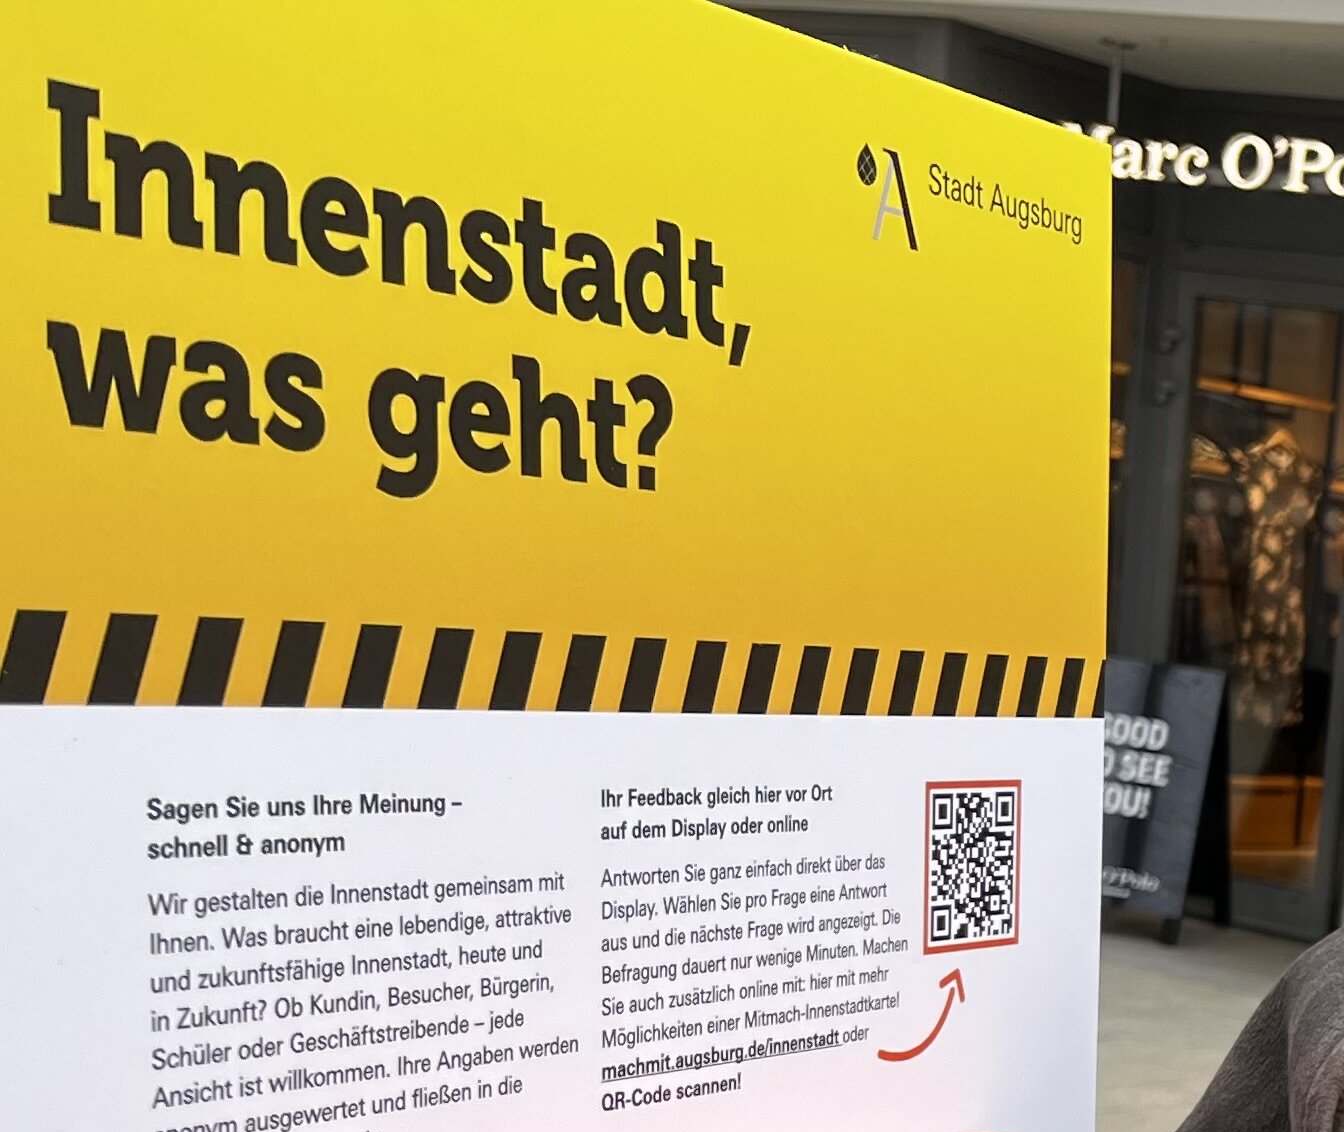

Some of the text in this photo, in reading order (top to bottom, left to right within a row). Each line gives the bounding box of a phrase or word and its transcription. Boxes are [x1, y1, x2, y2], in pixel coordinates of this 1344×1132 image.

[1062, 122, 1209, 186] arc
[46, 78, 751, 373] Innenstadt,
[929, 164, 1081, 245] Stadt Augsburg
[46, 320, 673, 498] was geht?
[1104, 711, 1170, 750] OOD
[1117, 749, 1173, 787] SEE
[147, 793, 445, 825] Sagen Sie uns Ihre Meinung
[601, 784, 832, 809] Ihr Feedback gleich hier vor Ort
[1104, 780, 1151, 819] OU!
[147, 834, 345, 859] schnell & anonym
[601, 815, 808, 840] auf dem Display oder online
[601, 854, 885, 887] Antworten Sie ganz einfach direkt über das
[147, 872, 565, 918] Wir gestalten die Innenstadt gemeinsam mit
[602, 883, 887, 923] Display. Wählen Sie pro Frage eine Antwort
[150, 905, 571, 955] Ihnen. Was braucht eine lebendige, attraktive
[601, 909, 900, 952] aus und die nächste Frage wird angezeigt. Die
[150, 939, 542, 993] und zukunftsfähige Innenstadt, heute und
[602, 937, 908, 984] Befragung dauert nur wenige Minuten. Machen
[151, 973, 554, 1032] in Zukunft? Ob Kundin, Besucher, Bürgerin,
[602, 966, 889, 1016] Sie auch zusätzlich online mit: hier mit mehr
[152, 1008, 524, 1070] Schüler oder Geschäftstreibende jede
[601, 1025, 869, 1083] machmit.augsburg.de/innenstadt oder
[602, 1020, 702, 1049] Möglichkeiten
[707, 1016, 740, 1034] einer
[152, 1036, 578, 1109] Ansicht ist willkommen. Ihre Angaben werden
[602, 1072, 741, 1111] QR-Code scannen!
[244, 1099, 366, 1132] ausgewertet
[372, 1090, 406, 1114] und
[412, 1085, 471, 1108] fließen
[478, 1080, 492, 1099] in
[498, 1076, 522, 1095] die
